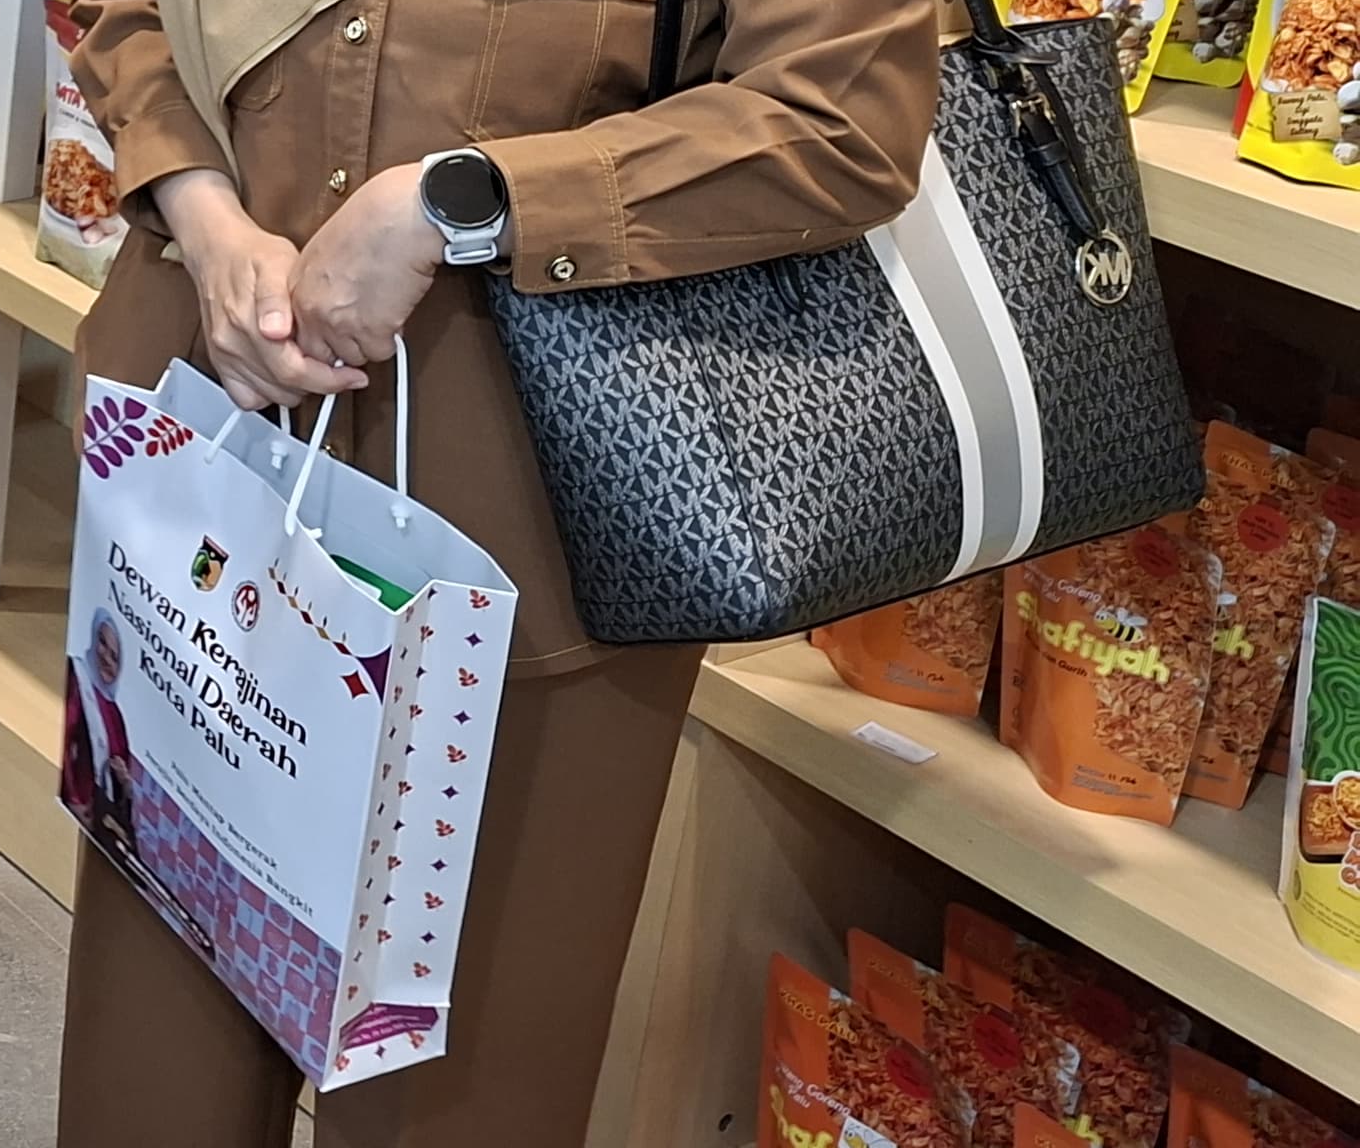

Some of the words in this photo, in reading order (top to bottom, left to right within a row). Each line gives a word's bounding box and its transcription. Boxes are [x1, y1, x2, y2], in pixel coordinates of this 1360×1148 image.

[108, 540, 187, 634] Dewan
[190, 618, 308, 747] Kerajinan
[108, 580, 199, 689] Nasional
[199, 674, 298, 780] Daerah
[139, 648, 185, 717] Kota
[191, 704, 241, 770] Palu
[266, 873, 313, 918] Bangkit
[806, 1083, 851, 1117] Goreng
